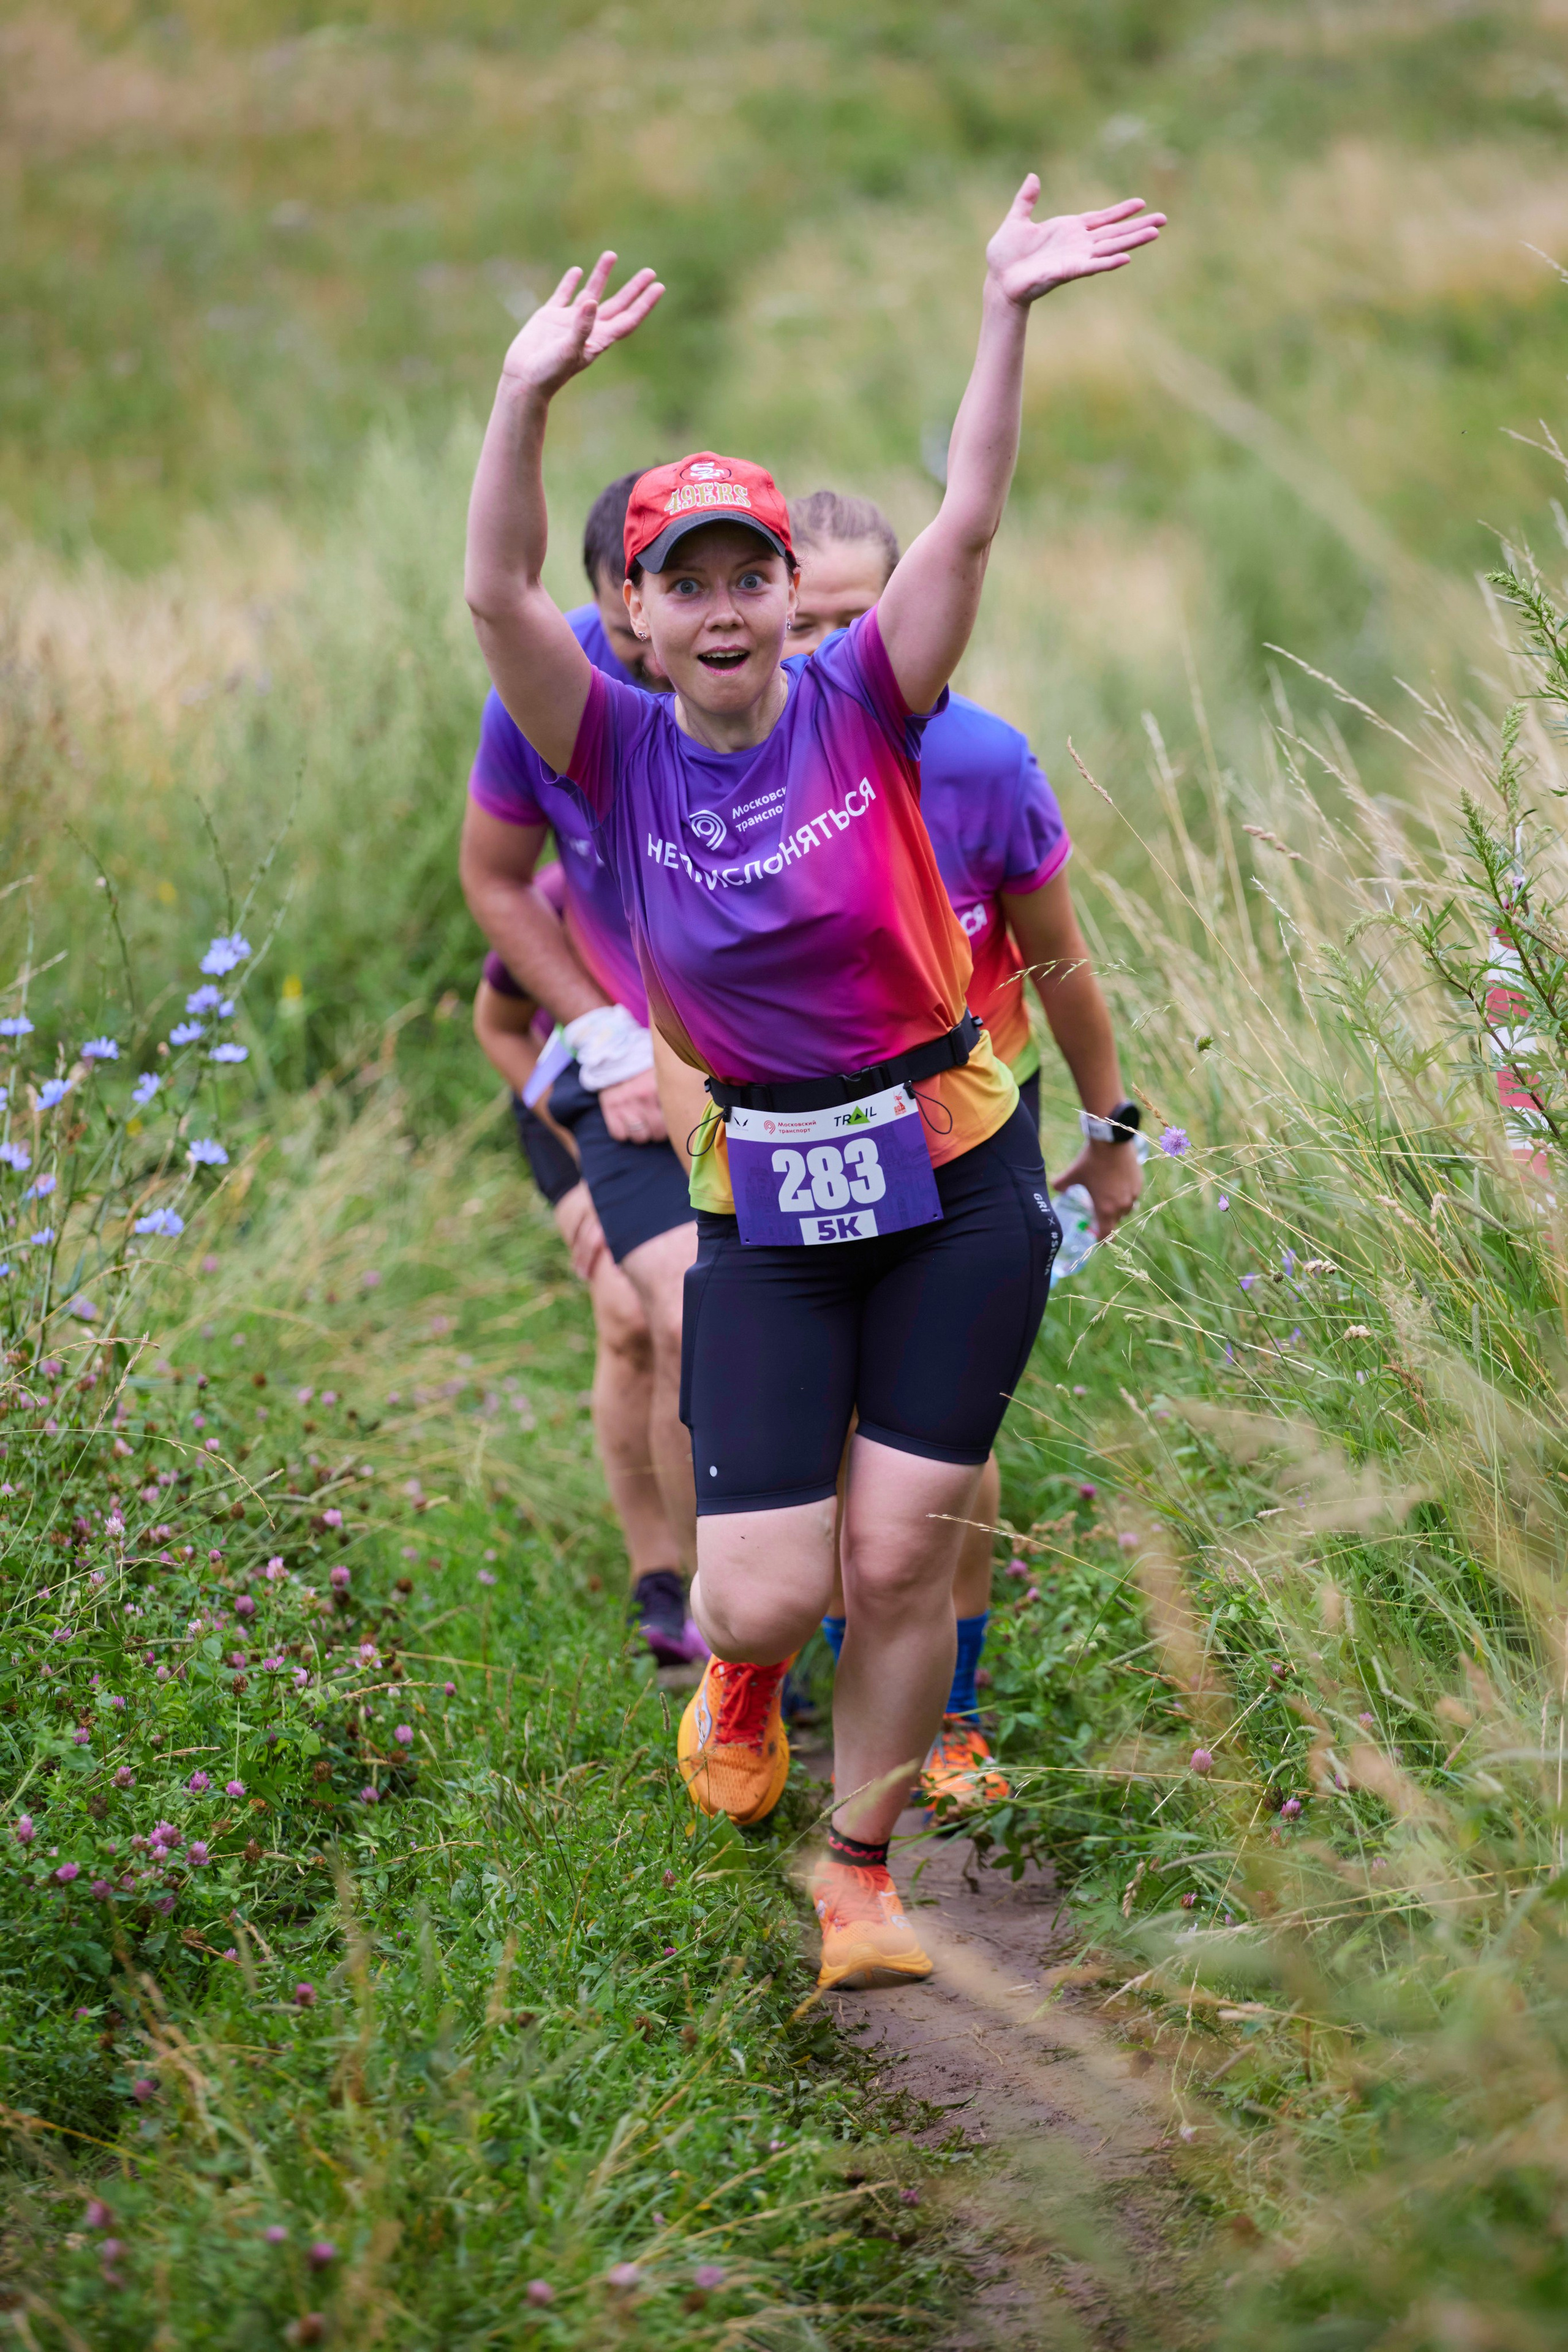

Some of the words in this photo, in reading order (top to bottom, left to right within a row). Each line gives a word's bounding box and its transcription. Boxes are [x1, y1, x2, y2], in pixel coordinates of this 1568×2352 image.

[664, 481, 751, 515] 49ERS
[736, 803, 784, 832] транспо
[834, 1106, 877, 1127] TRAIL
[771, 1137, 886, 1212] 283
[817, 1215, 863, 1241] 5K
